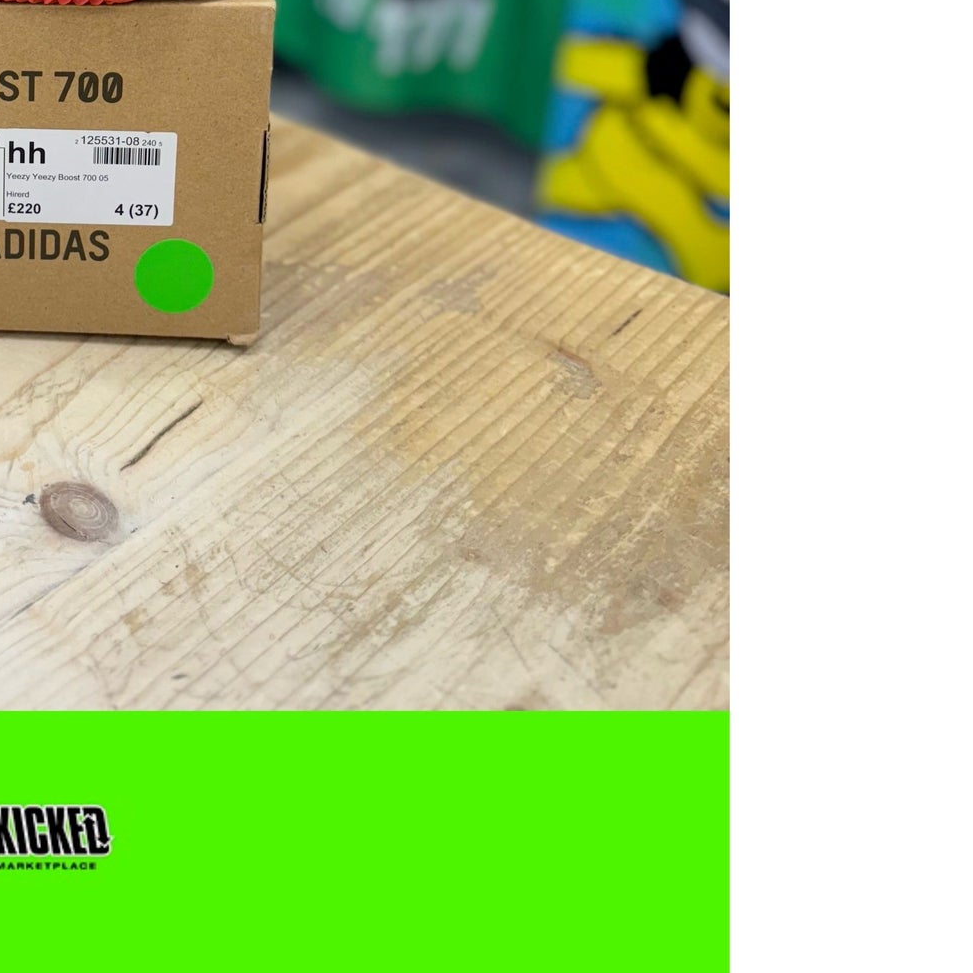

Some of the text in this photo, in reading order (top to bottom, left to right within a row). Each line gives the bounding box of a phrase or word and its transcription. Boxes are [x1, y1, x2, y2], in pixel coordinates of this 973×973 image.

[54, 71, 123, 103] 700
[81, 136, 140, 146] 125531-08
[8, 141, 46, 164] hh
[6, 173, 30, 181] Yeezy
[32, 173, 56, 182] Yeezy
[58, 174, 80, 182] Boost
[8, 202, 41, 214] £220
[114, 204, 159, 219] 4 (37)
